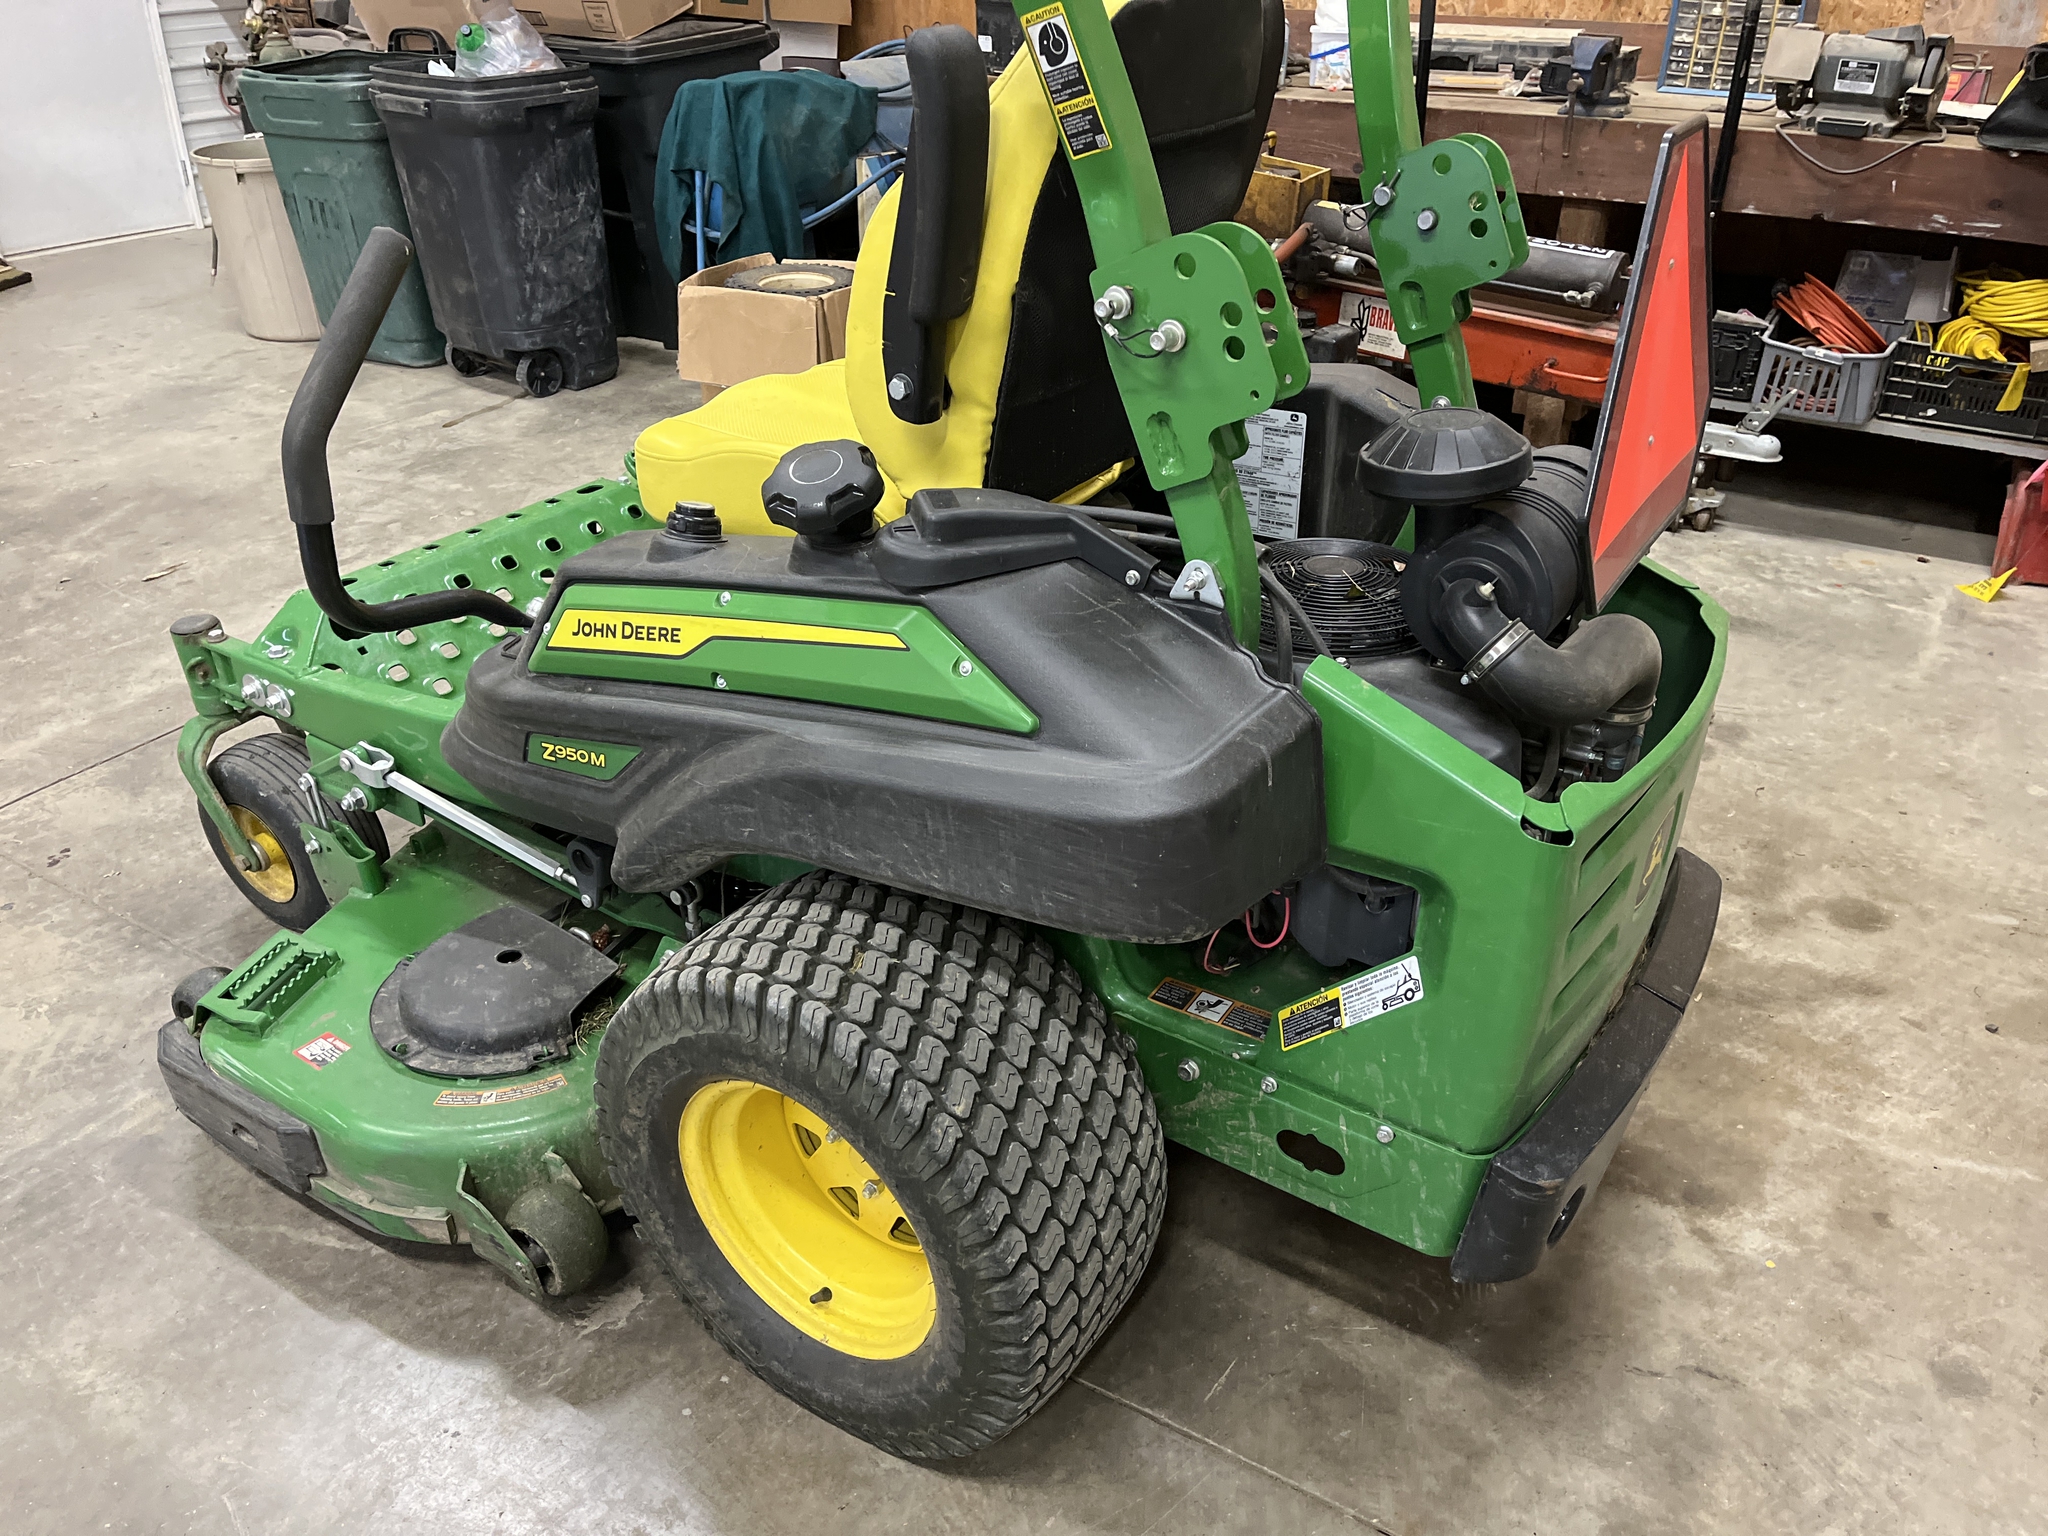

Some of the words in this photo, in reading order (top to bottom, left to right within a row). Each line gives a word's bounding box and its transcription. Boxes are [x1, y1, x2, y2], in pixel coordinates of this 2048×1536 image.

[1030, 5, 1060, 23] CAUTION
[1062, 97, 1094, 114] ATENCIÓN
[1369, 306, 1397, 332] BRAV
[572, 618, 617, 639] JOHN
[622, 621, 681, 643] DEERE
[540, 742, 606, 768] Z950M
[1296, 994, 1328, 1013] ATENCIÓN
